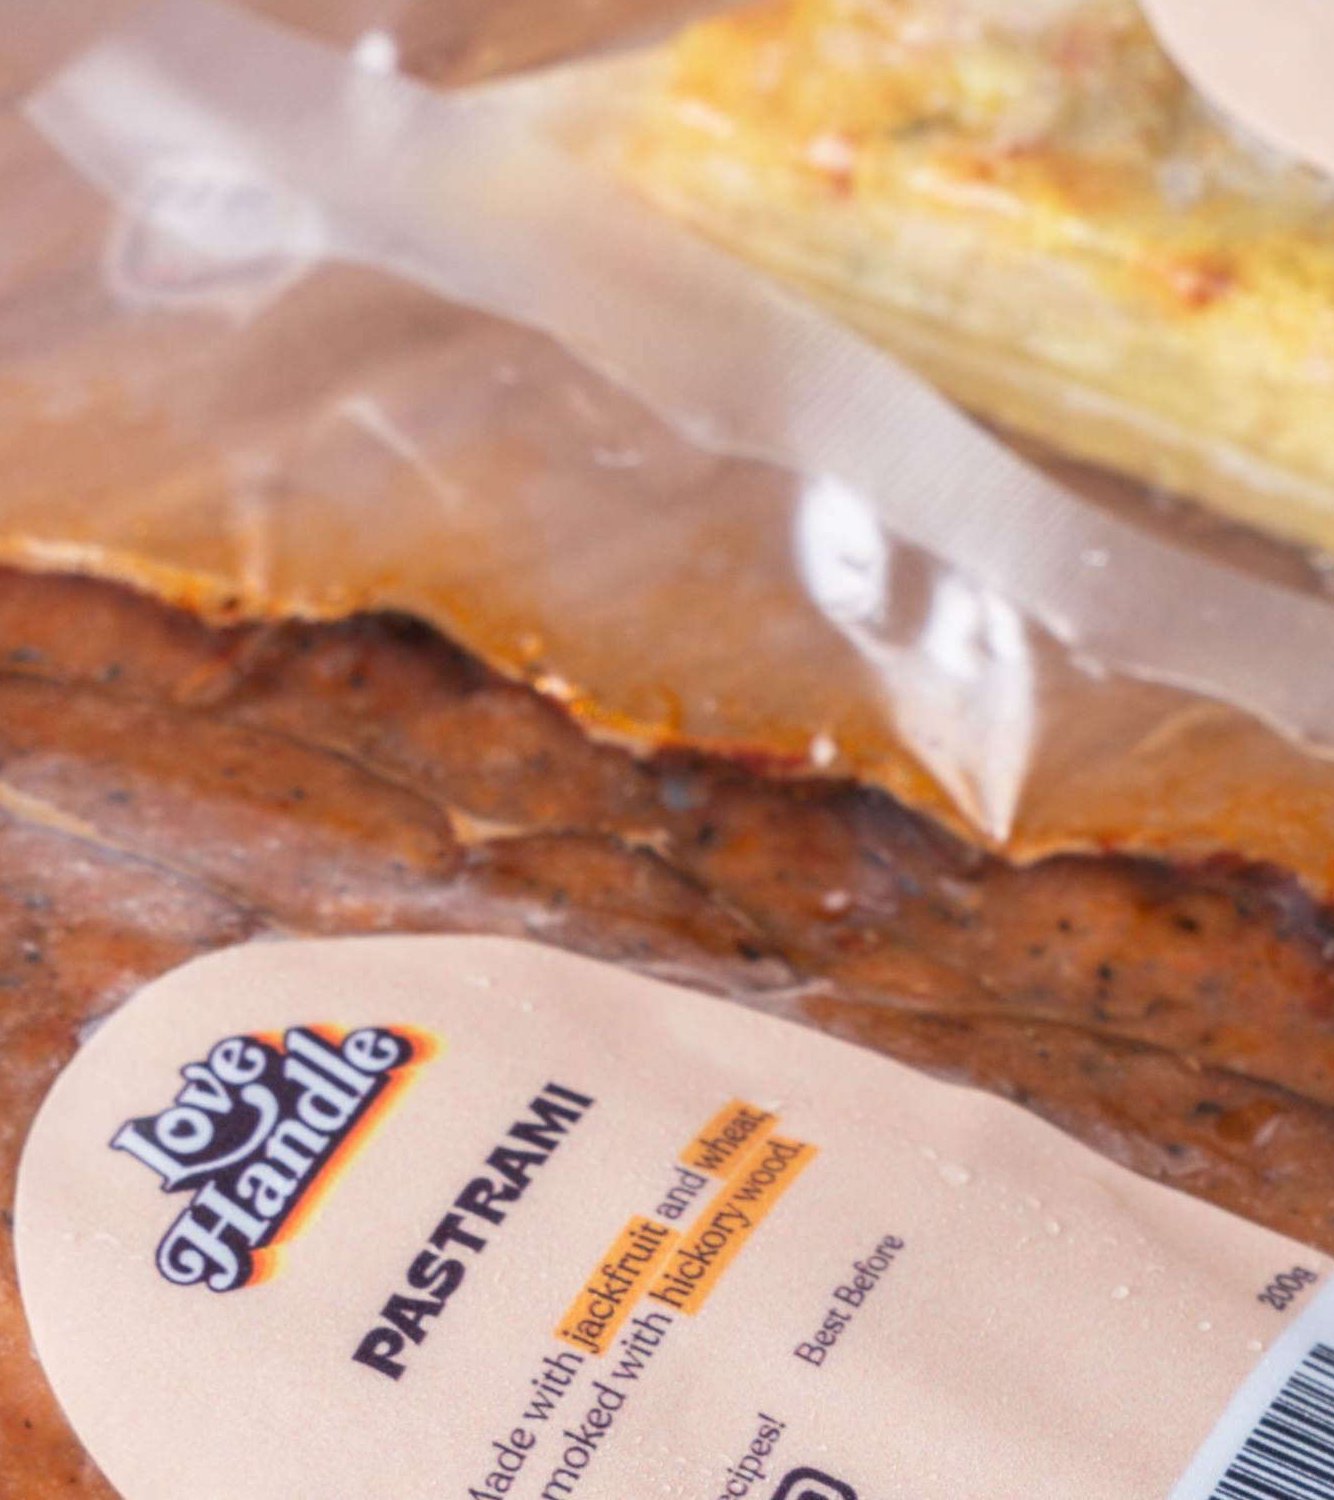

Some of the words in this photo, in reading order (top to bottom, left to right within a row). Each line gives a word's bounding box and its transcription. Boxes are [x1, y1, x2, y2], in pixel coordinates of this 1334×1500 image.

[156, 1026, 409, 1292] Handle
[351, 1081, 595, 1381] PASTRAMI
[612, 1306, 672, 1382] with
[650, 1205, 746, 1309] hickory
[733, 1140, 805, 1206] wood.
[525, 1350, 585, 1424] with
[562, 1220, 669, 1353] jackfruit
[655, 1165, 708, 1220] and
[793, 1301, 851, 1367] Best
[834, 1233, 905, 1308] Before
[1257, 1264, 1318, 1312] 200g
